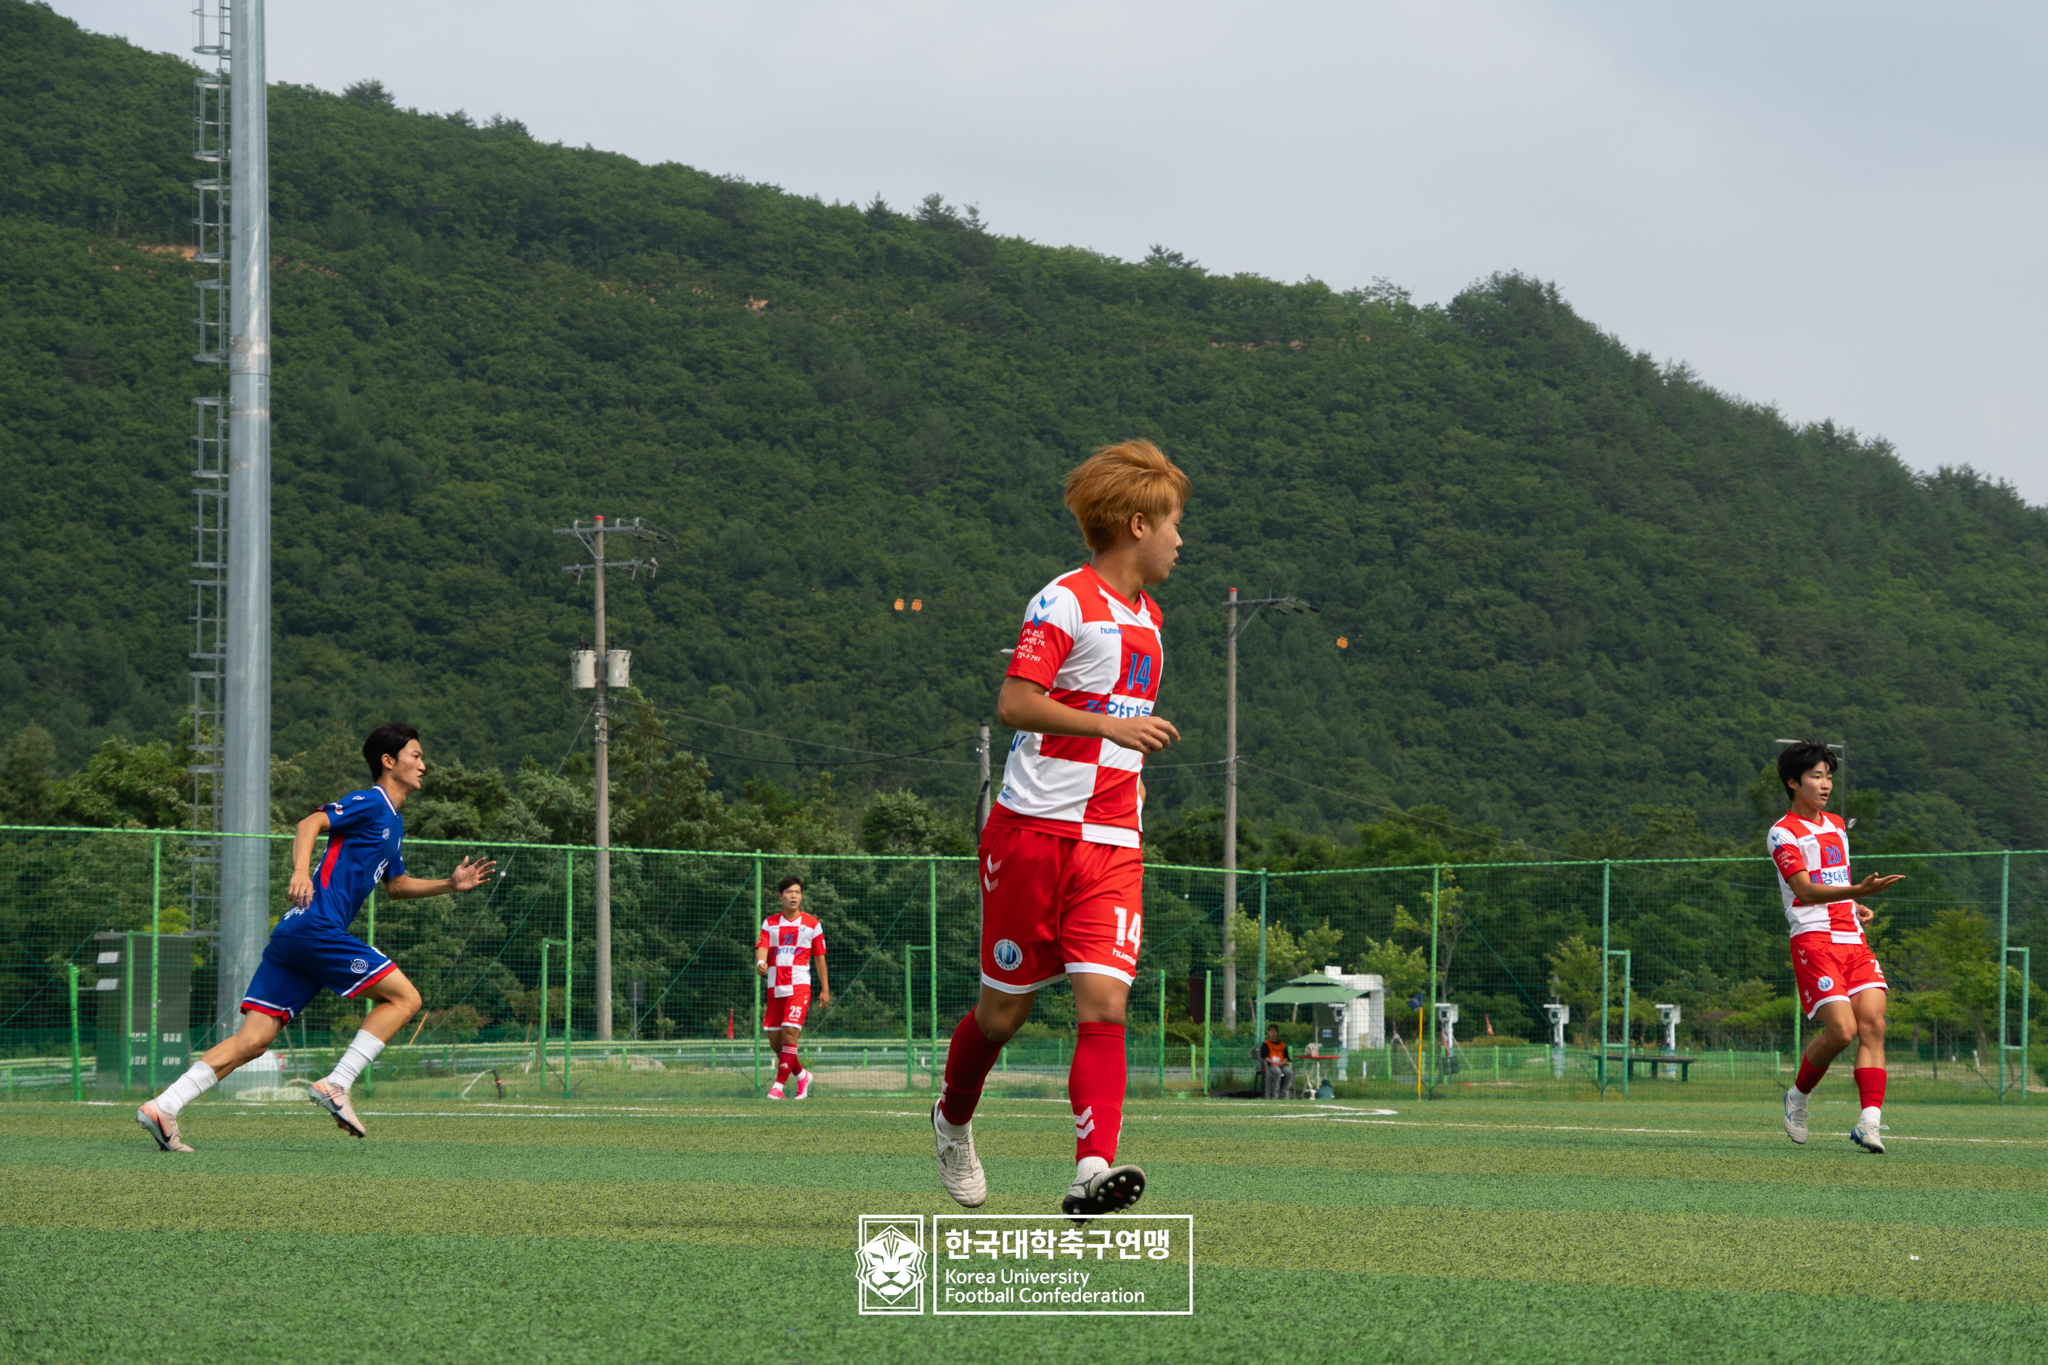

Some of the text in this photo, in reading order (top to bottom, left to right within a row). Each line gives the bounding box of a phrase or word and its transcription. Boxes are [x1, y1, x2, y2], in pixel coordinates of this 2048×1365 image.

[1127, 653, 1151, 693] 14
[1825, 846, 1842, 865] 20
[1114, 906, 1141, 955] 14
[788, 1005, 802, 1018] 25
